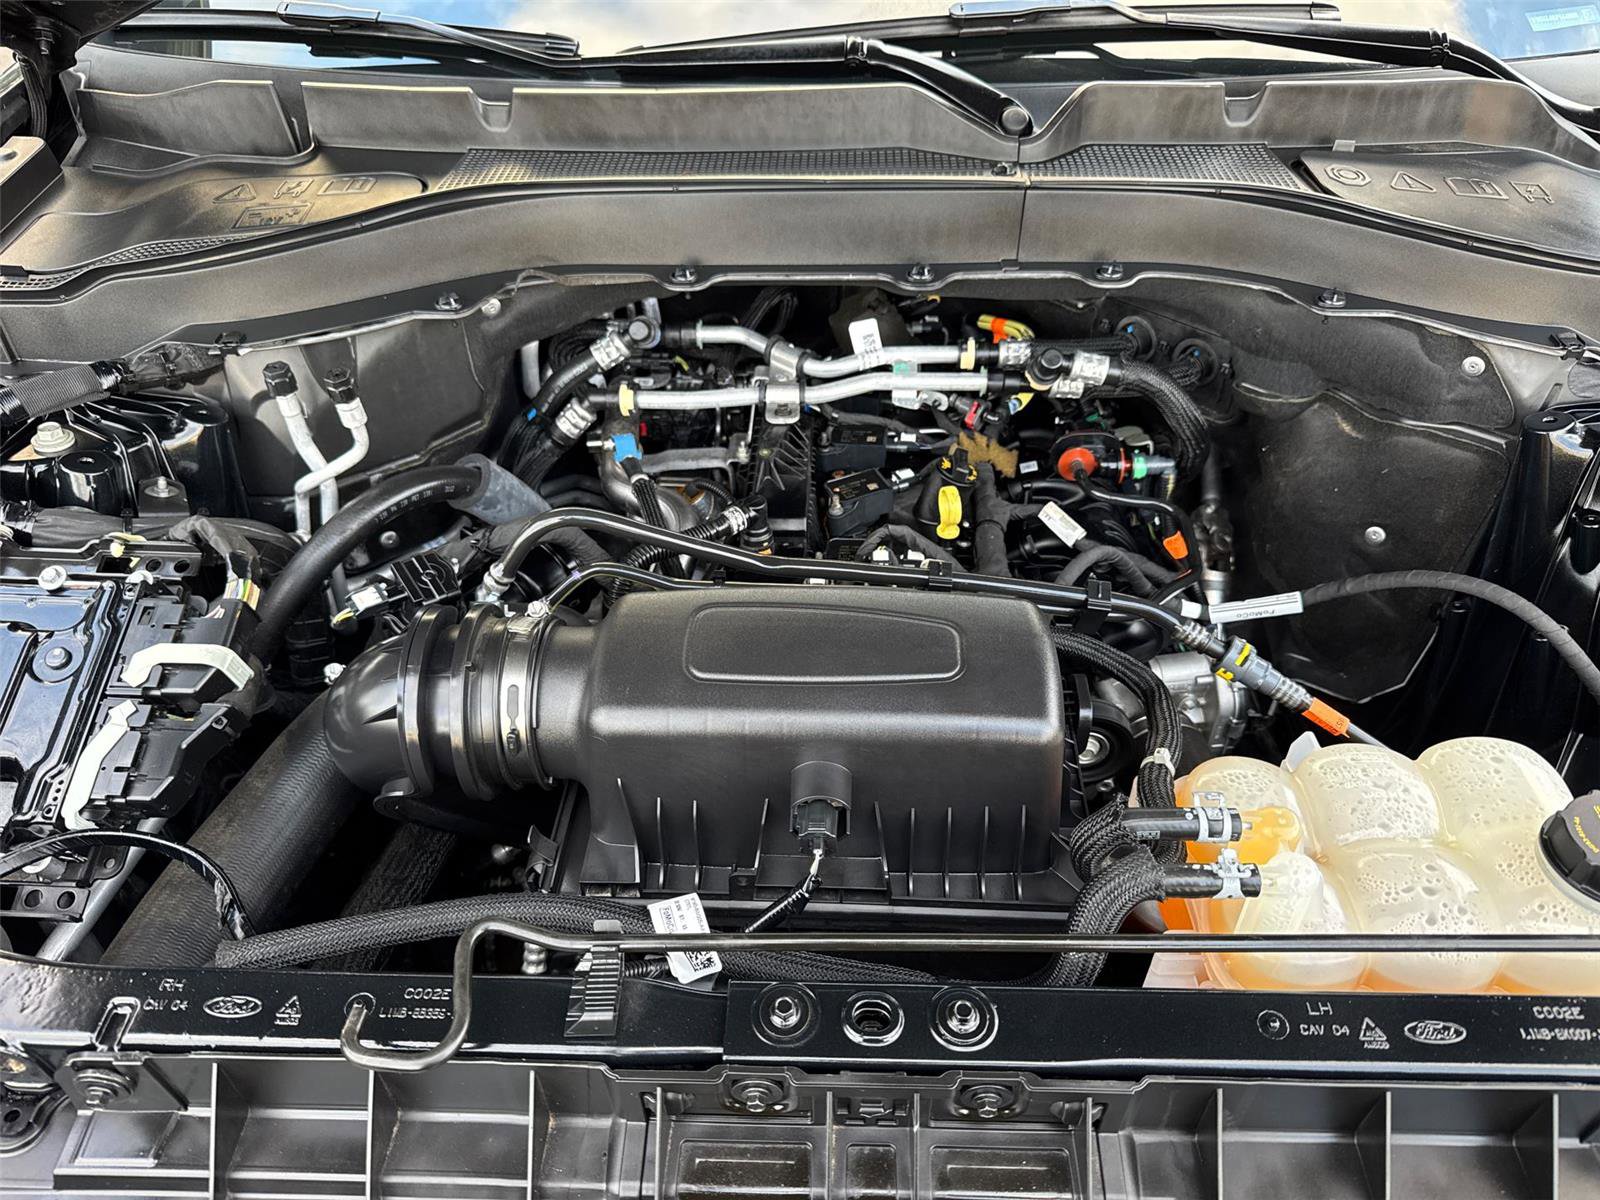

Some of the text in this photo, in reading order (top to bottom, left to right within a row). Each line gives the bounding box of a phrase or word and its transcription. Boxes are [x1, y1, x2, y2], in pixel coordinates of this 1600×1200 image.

[1235, 609, 1276, 618] FoMoCo
[158, 978, 187, 991] RH
[207, 998, 259, 1016] Ford
[1305, 1001, 1333, 1015] LH
[1299, 1023, 1324, 1036] CAV
[1411, 1021, 1460, 1041] Ford
